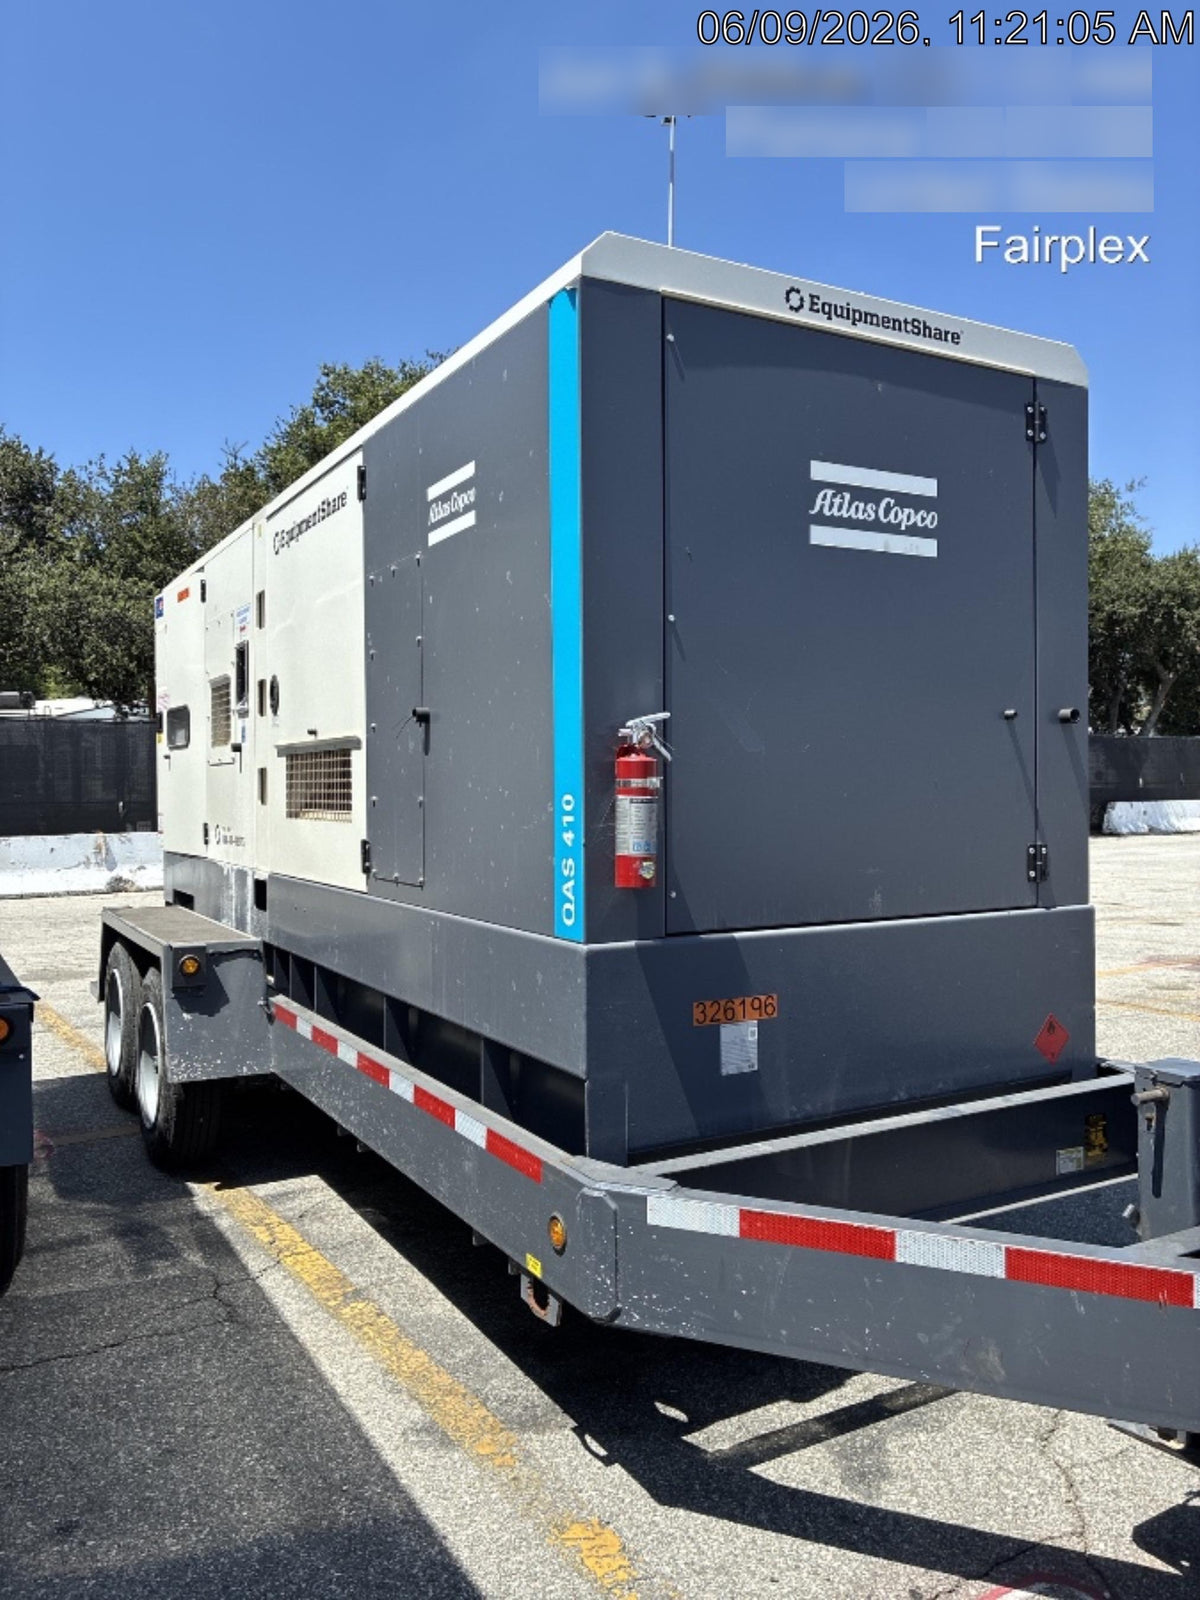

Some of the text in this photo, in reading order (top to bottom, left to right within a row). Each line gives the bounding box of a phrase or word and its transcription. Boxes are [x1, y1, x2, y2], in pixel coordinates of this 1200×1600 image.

[808, 293, 961, 345] EquipmentShare
[280, 491, 348, 549] EquipmentShare
[427, 500, 451, 527] Atlas
[808, 488, 938, 531] Atlas Copco
[561, 793, 576, 927] QAS 410
[695, 995, 776, 1025] 326196
